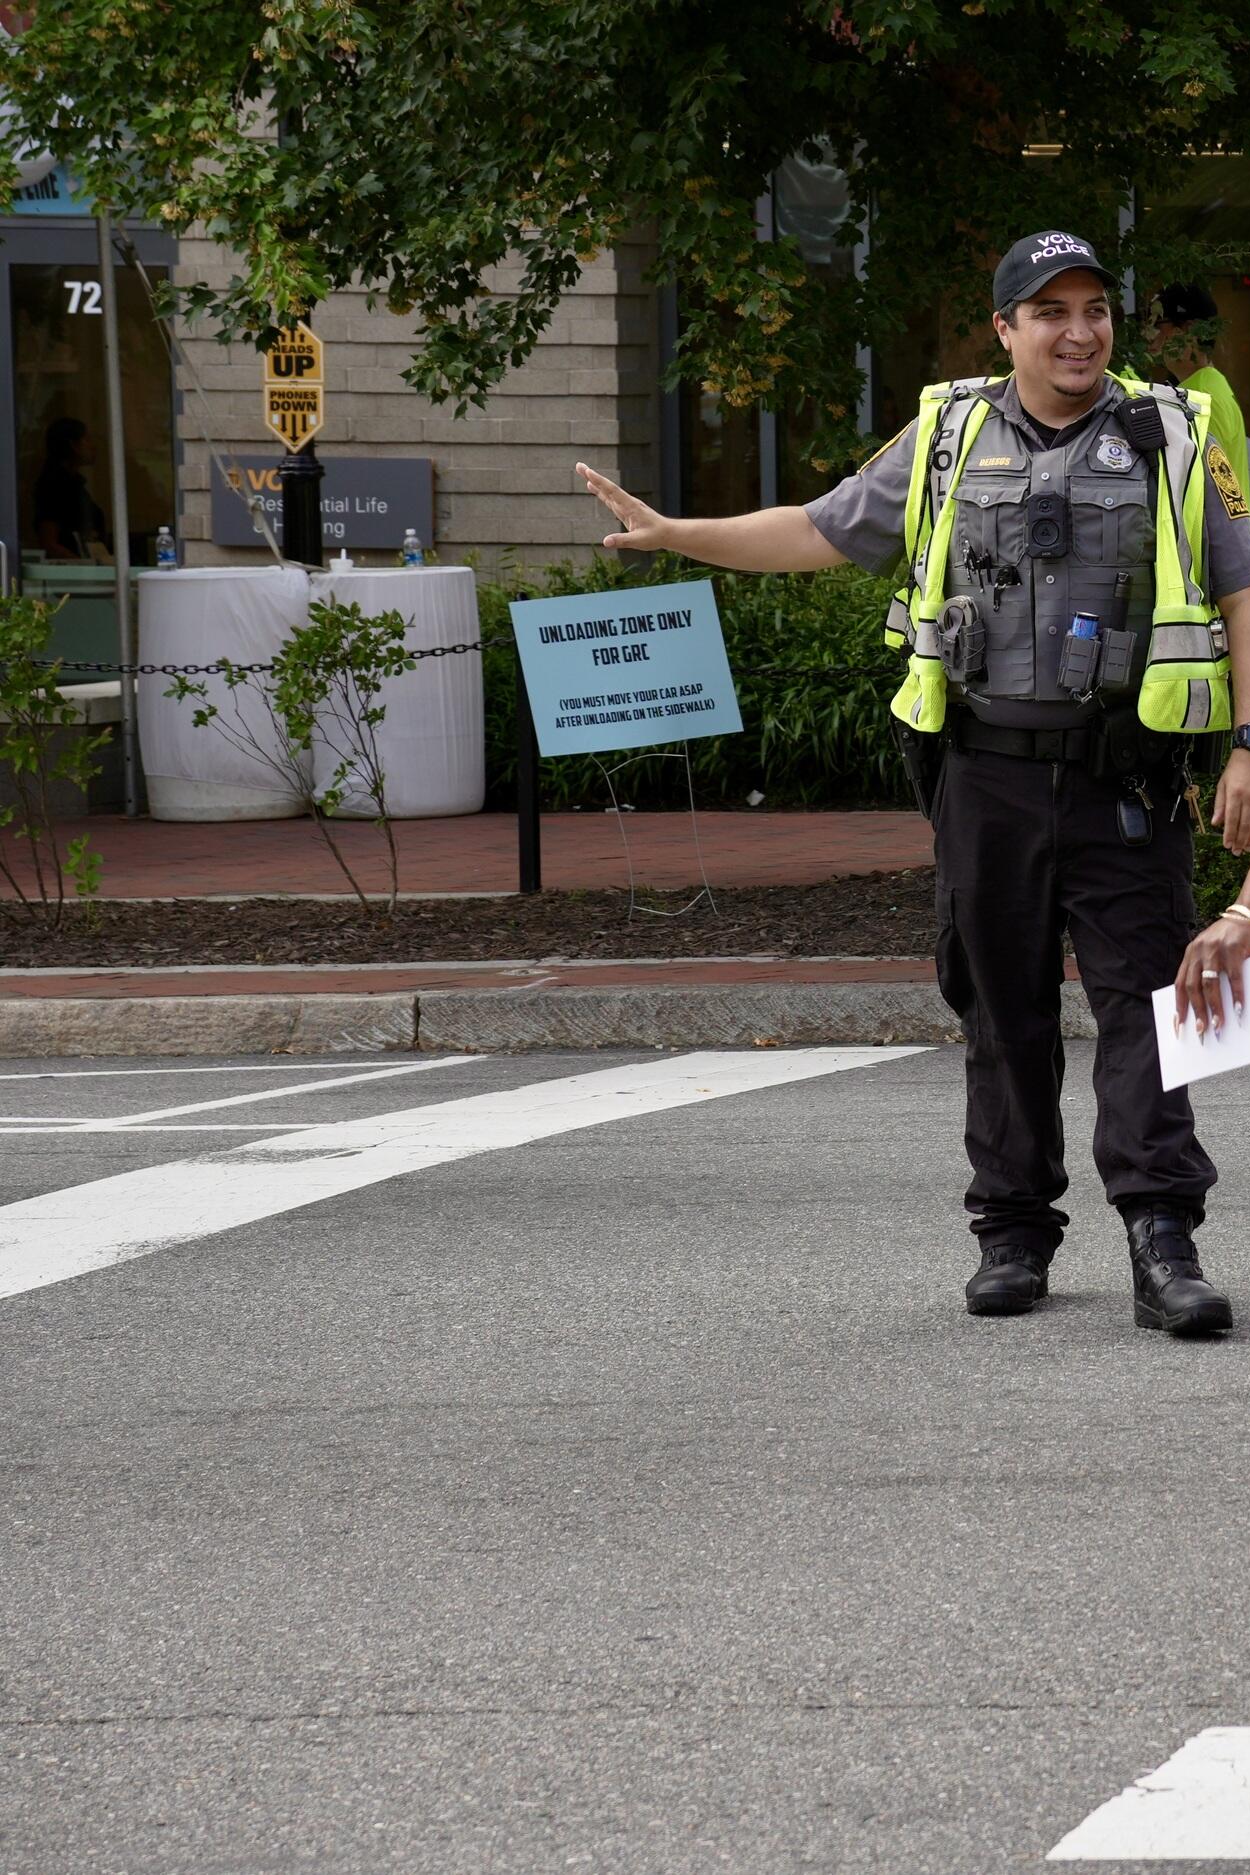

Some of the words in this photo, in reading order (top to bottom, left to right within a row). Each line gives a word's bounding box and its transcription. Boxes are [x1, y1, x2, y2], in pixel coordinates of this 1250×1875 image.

[1037, 233, 1074, 247] VCU
[1030, 244, 1090, 263] POLICE
[63, 281, 103, 315] 72
[273, 344, 314, 354] HEADS
[273, 354, 315, 377] UP
[270, 391, 318, 400] PHONES
[270, 401, 317, 412] DOWN
[246, 468, 283, 491] VC
[253, 494, 349, 513] Restial
[355, 497, 389, 514] Life
[539, 619, 618, 644] UNLOADING
[619, 614, 656, 635] ZONE
[657, 609, 692, 631] ONLY
[592, 646, 621, 666] FOR
[623, 643, 650, 664] GRC
[559, 697, 583, 711] (YOU
[583, 694, 607, 708] MUST
[607, 692, 632, 706] MOVE
[633, 690, 659, 703] YOUR
[659, 687, 678, 700] CAR
[679, 683, 703, 696] ASAP
[555, 717, 583, 729] AFTER
[583, 711, 632, 726] UNLOADING
[633, 709, 646, 720] ON
[646, 707, 664, 719] THE
[664, 698, 715, 716] SIDEWALK)
